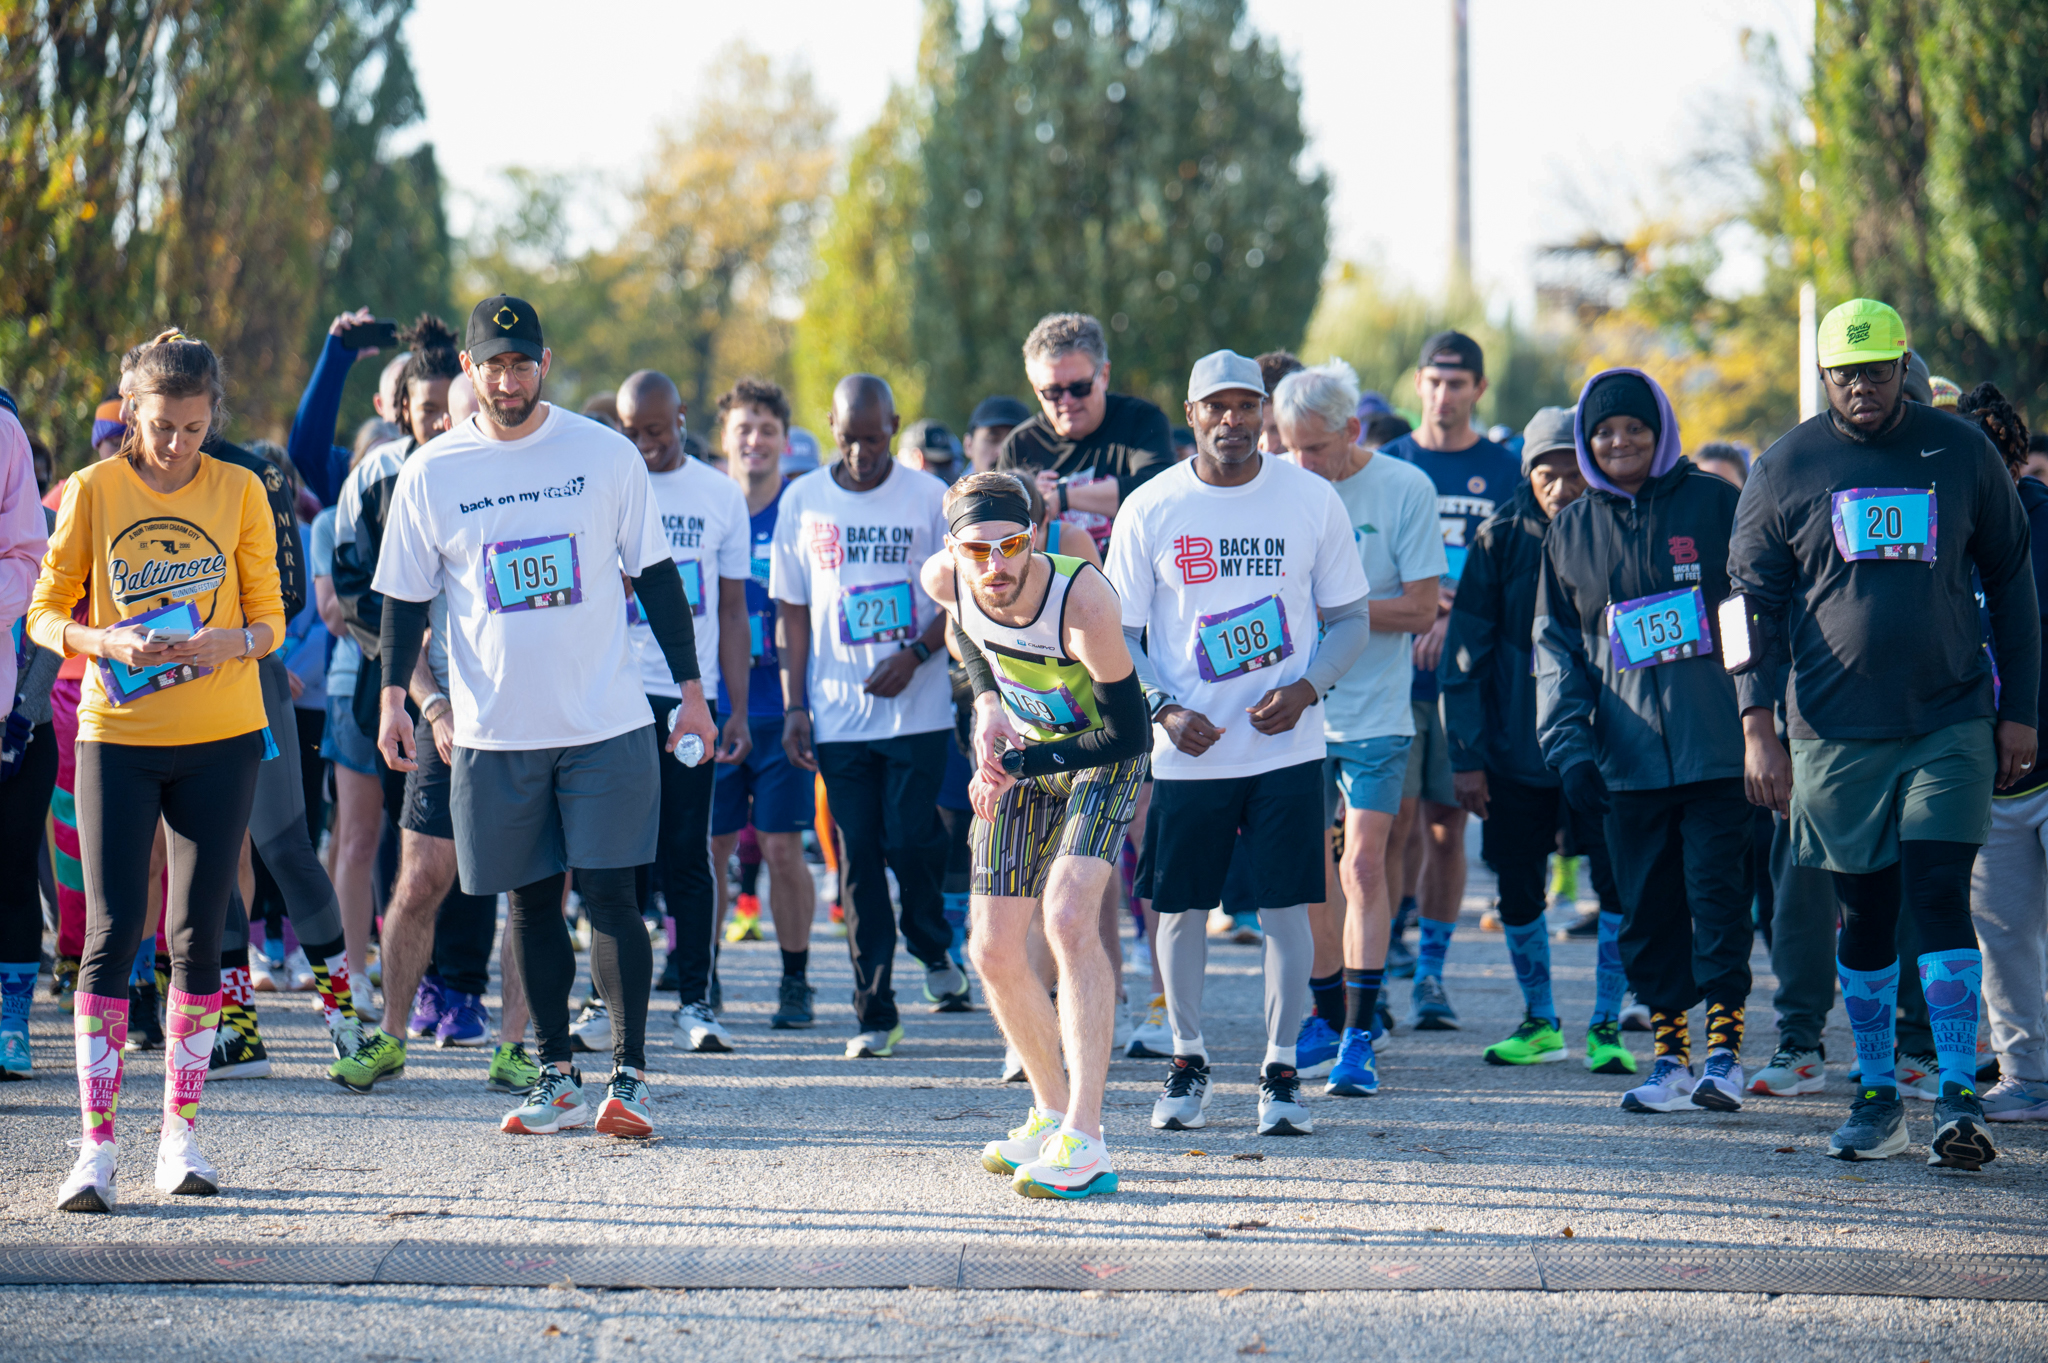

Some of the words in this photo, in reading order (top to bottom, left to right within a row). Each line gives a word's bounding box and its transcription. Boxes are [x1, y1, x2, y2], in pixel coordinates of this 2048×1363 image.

[460, 497, 494, 514] back
[498, 494, 515, 505] on
[519, 491, 540, 502] my
[543, 479, 577, 498] feet
[661, 514, 684, 530] ACK
[688, 515, 705, 531] ON
[1866, 505, 1903, 540] 20
[133, 527, 145, 538] RUN
[143, 523, 169, 532] THROUGH
[169, 523, 189, 534] CHARM
[187, 529, 201, 541] CITY
[847, 526, 887, 543] BACK
[892, 527, 913, 543] ON
[848, 546, 869, 563] MY
[1219, 537, 1260, 557] BACK
[1264, 538, 1285, 556] ON
[109, 553, 226, 596] Baltimore
[507, 554, 559, 591] 195
[1220, 558, 1243, 577] MY
[1246, 558, 1286, 577] FEET.
[1672, 563, 1690, 575] BACK
[1690, 562, 1701, 572] ON
[1673, 573, 1684, 582] MY
[172, 585, 198, 597] RUNNING
[856, 598, 899, 628] 221
[1633, 609, 1683, 648] 153
[1217, 619, 1270, 661] 198
[1008, 690, 1056, 722] 169
[1856, 1029, 1890, 1043] ALTH
[1930, 1021, 1977, 1035] EALTH
[1935, 1031, 1967, 1043] ARE
[1936, 1044, 1976, 1058] OMELESS
[82, 1079, 114, 1090] ALTH
[171, 1090, 201, 1099] HOMEL
[85, 1100, 113, 1108] ELESS
